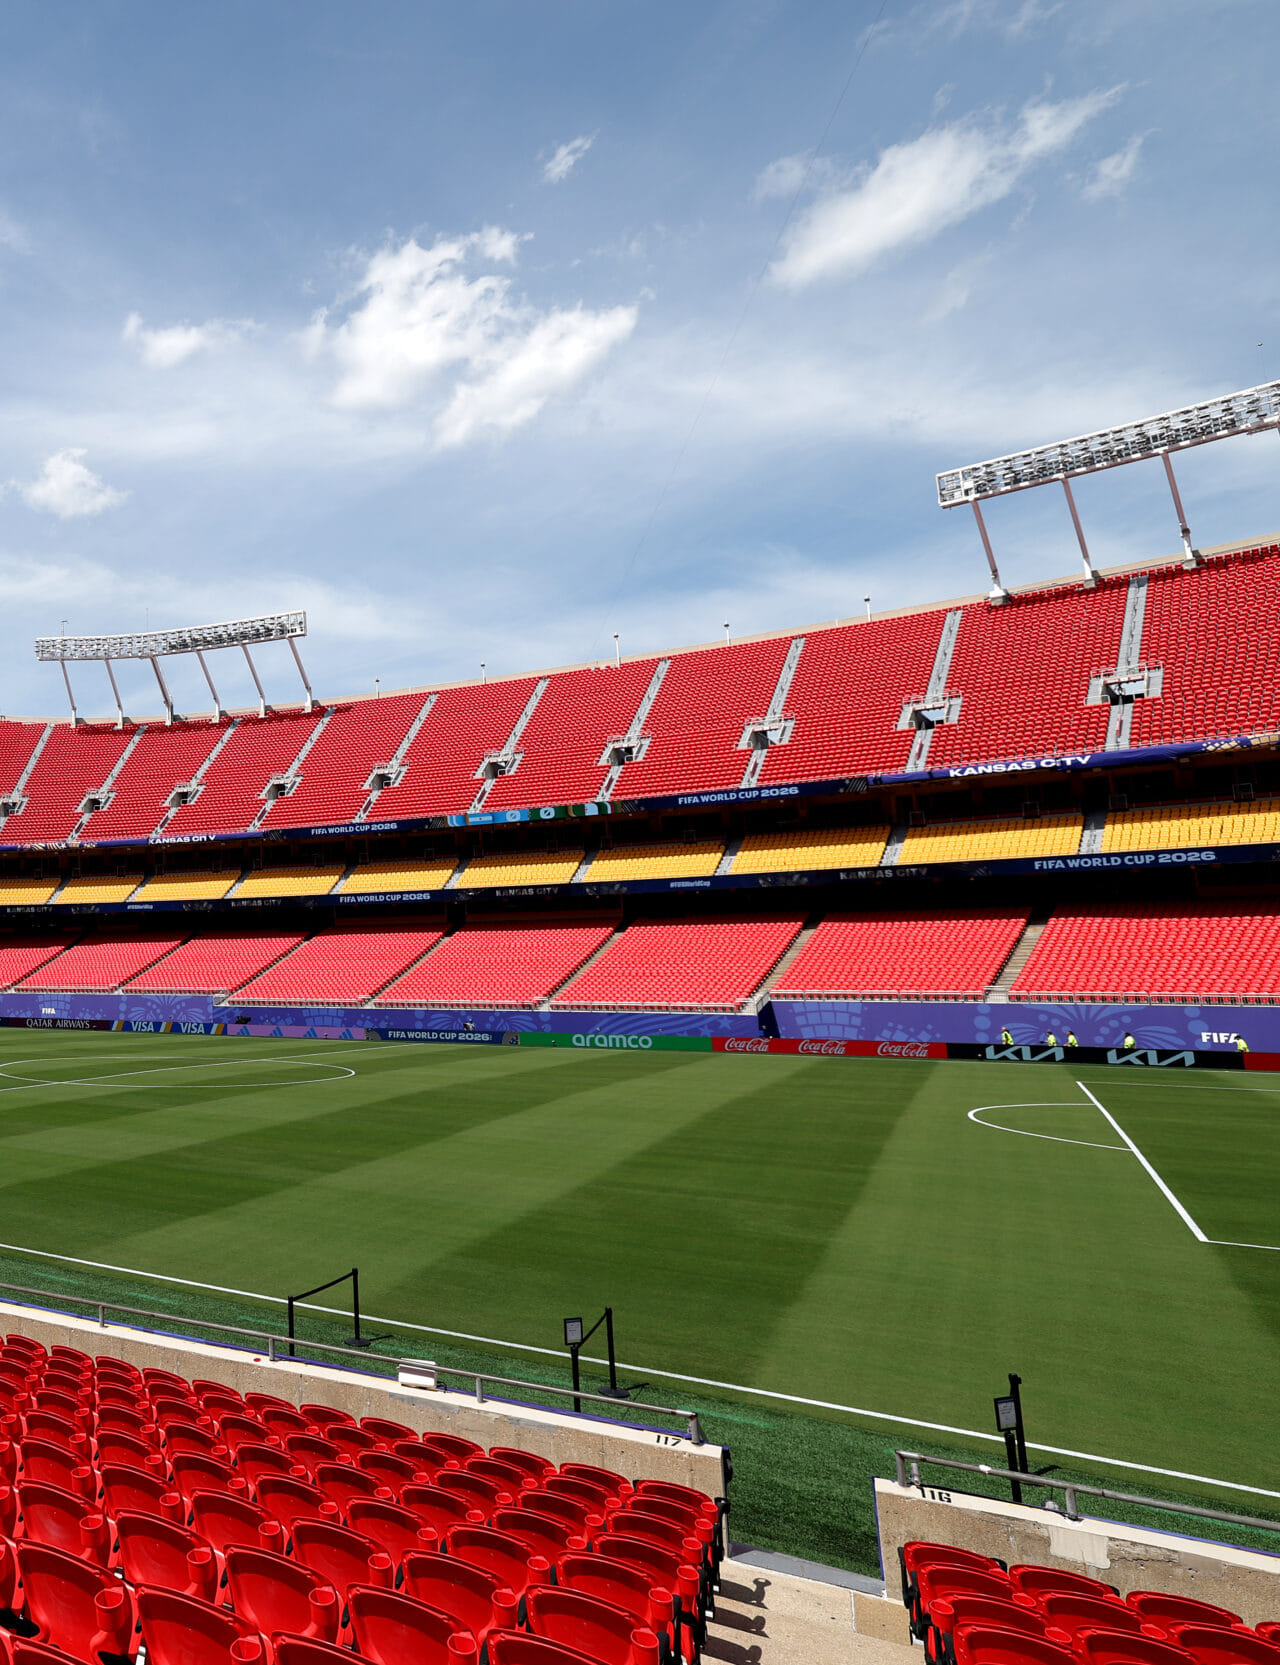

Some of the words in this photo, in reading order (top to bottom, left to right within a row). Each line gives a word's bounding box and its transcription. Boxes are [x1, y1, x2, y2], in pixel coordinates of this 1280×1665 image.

[949, 760, 1037, 778] KANSAS
[1040, 755, 1092, 768] CITY
[678, 795, 699, 805] FIFA
[700, 792, 737, 802] WORLD
[738, 790, 760, 800] CUP
[761, 786, 799, 798] 2026
[311, 827, 328, 836] FIFA
[329, 825, 355, 834] WORLD
[355, 823, 370, 832] CUP
[371, 822, 398, 831] 2026
[149, 837, 190, 845] KANSAS
[1034, 859, 1065, 871] FIFA
[1066, 856, 1120, 869] WORLD
[1123, 854, 1156, 867] CUP
[1159, 851, 1216, 864] 2026
[839, 869, 893, 880] KANSAS
[896, 867, 928, 878] CITY
[340, 895, 357, 903] FIFA
[357, 894, 386, 902] WORLD
[386, 893, 402, 902] CUP
[402, 892, 430, 901] 2026
[495, 888, 534, 897] KANSAS
[536, 887, 559, 895] CITY
[231, 899, 263, 908] KANSAS
[42, 1007, 56, 1015] FIFA
[26, 1018, 53, 1029] QATAR
[56, 1019, 90, 1030] AIRWAYS
[131, 1022, 155, 1033] VISA
[179, 1023, 205, 1034] VISA
[388, 1030, 407, 1039] FIFA
[407, 1031, 438, 1040] WORLD
[439, 1031, 457, 1041] CUP
[458, 1032, 490, 1041] 2026
[572, 1034, 653, 1048] aramco
[1201, 1032, 1239, 1044] FIFA
[985, 1045, 1064, 1062] KIA
[1106, 1048, 1195, 1067] KIA
[656, 1434, 682, 1446] 117
[919, 1487, 952, 1504] 116
